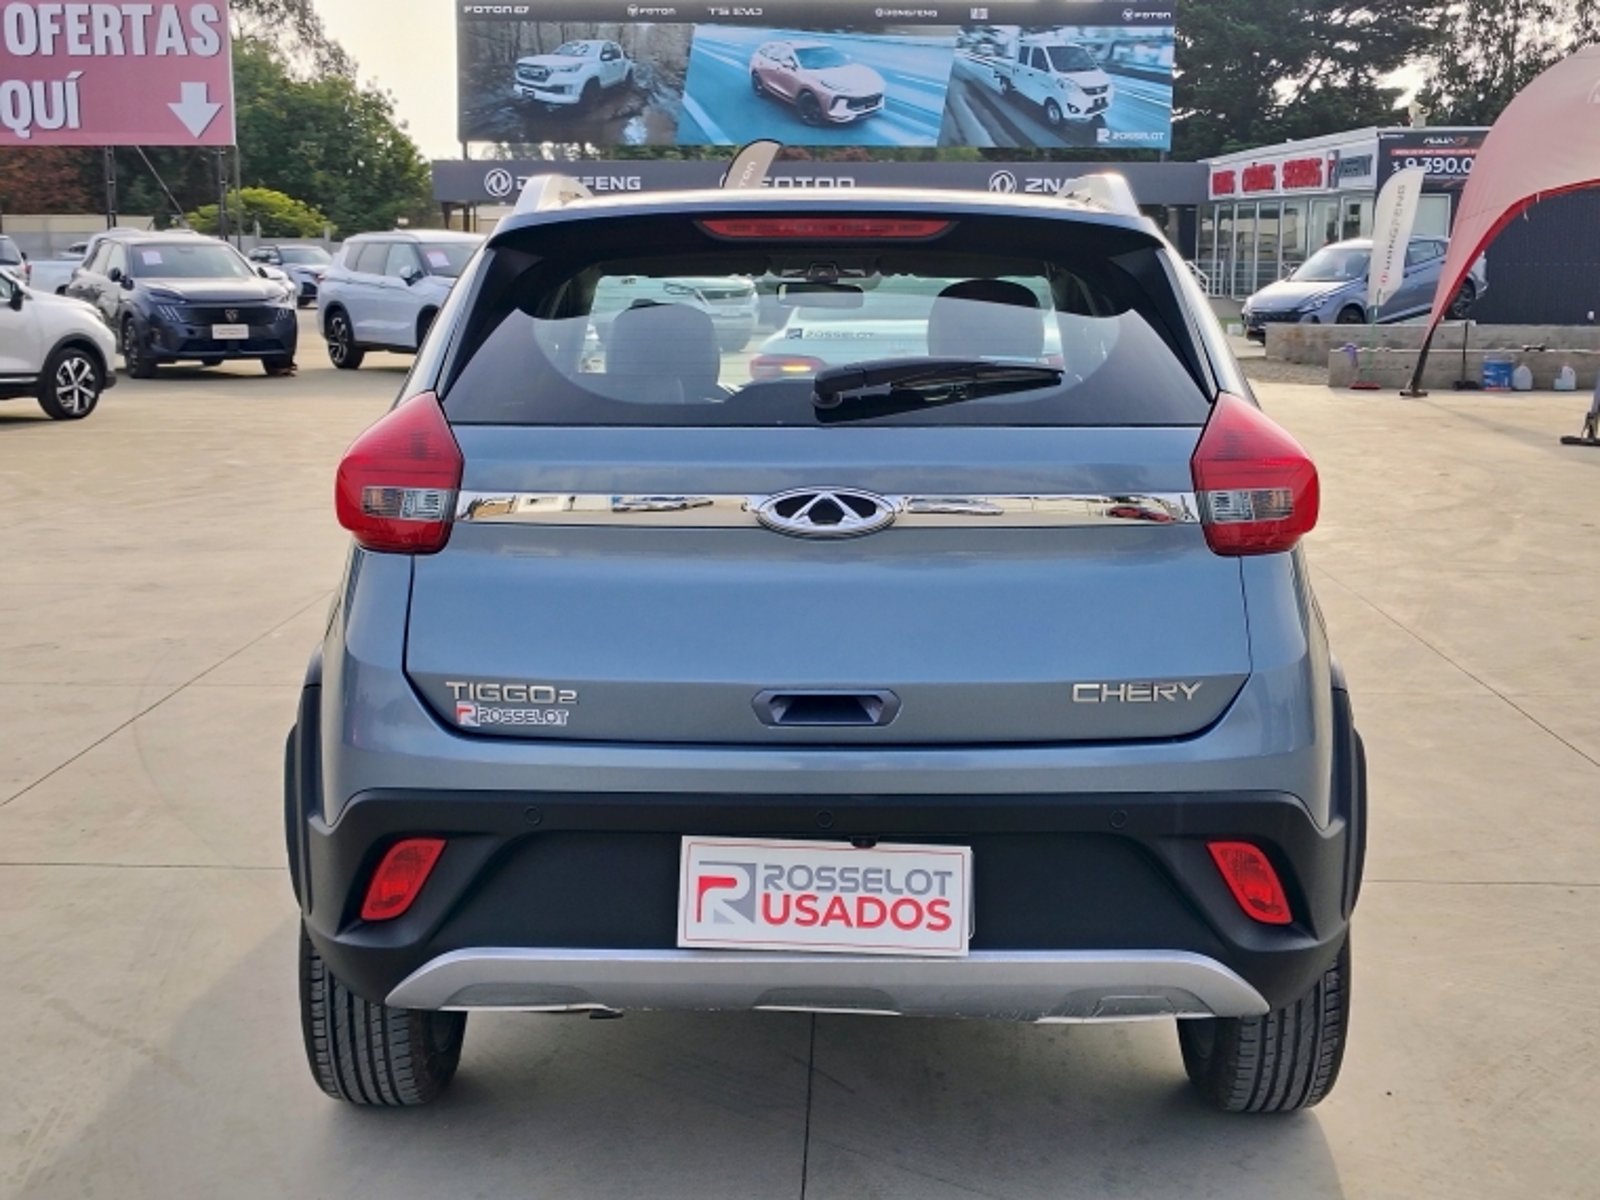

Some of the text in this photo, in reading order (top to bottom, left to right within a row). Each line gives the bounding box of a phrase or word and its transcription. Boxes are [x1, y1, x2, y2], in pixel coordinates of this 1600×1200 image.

[463, 5, 512, 14] FOTON
[4, 2, 222, 57] OFERTAS
[0, 70, 85, 140] QUÍ
[1073, 681, 1203, 703] CHERY
[479, 706, 569, 725] ROSSELOT
[763, 864, 953, 897] ROSSELOT
[762, 892, 952, 932] USADOS
